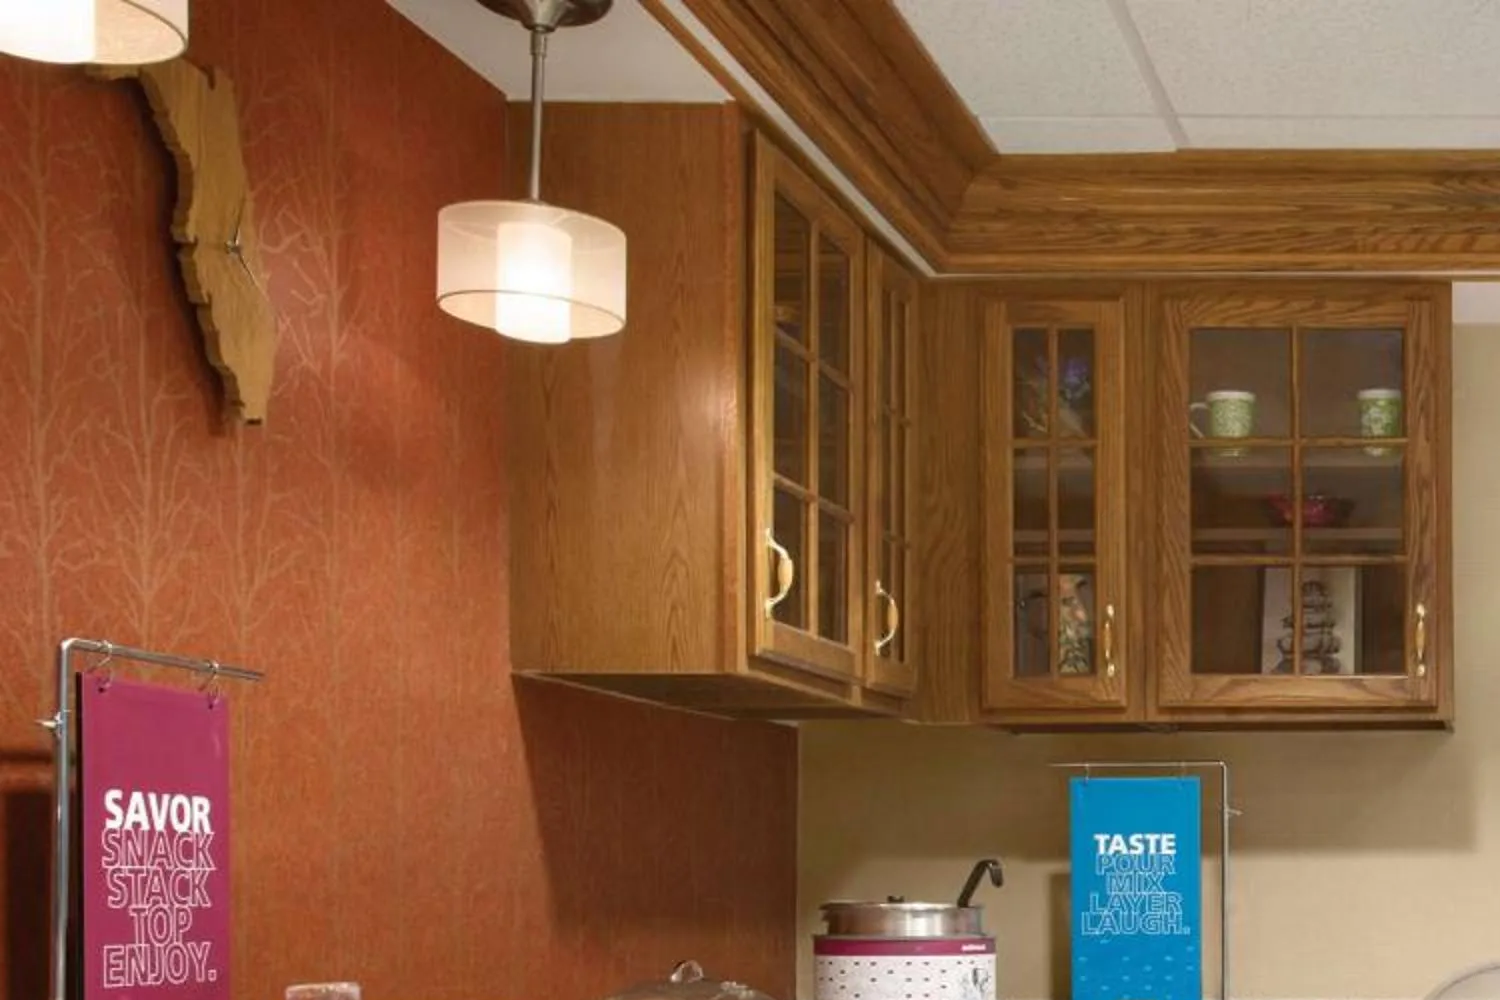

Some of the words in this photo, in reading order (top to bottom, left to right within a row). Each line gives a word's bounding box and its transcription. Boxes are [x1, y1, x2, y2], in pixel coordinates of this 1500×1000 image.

[104, 789, 212, 832] SAVOR
[102, 828, 216, 870] SNACK
[1094, 834, 1177, 855] TASTE
[1096, 853, 1176, 875] POUR
[107, 867, 212, 909] STACK
[1106, 872, 1165, 894] MIX
[1089, 892, 1183, 914] LAYER
[129, 905, 193, 946] TOP
[1081, 911, 1191, 935] LAUGH.
[103, 942, 217, 988] ENJOY.
